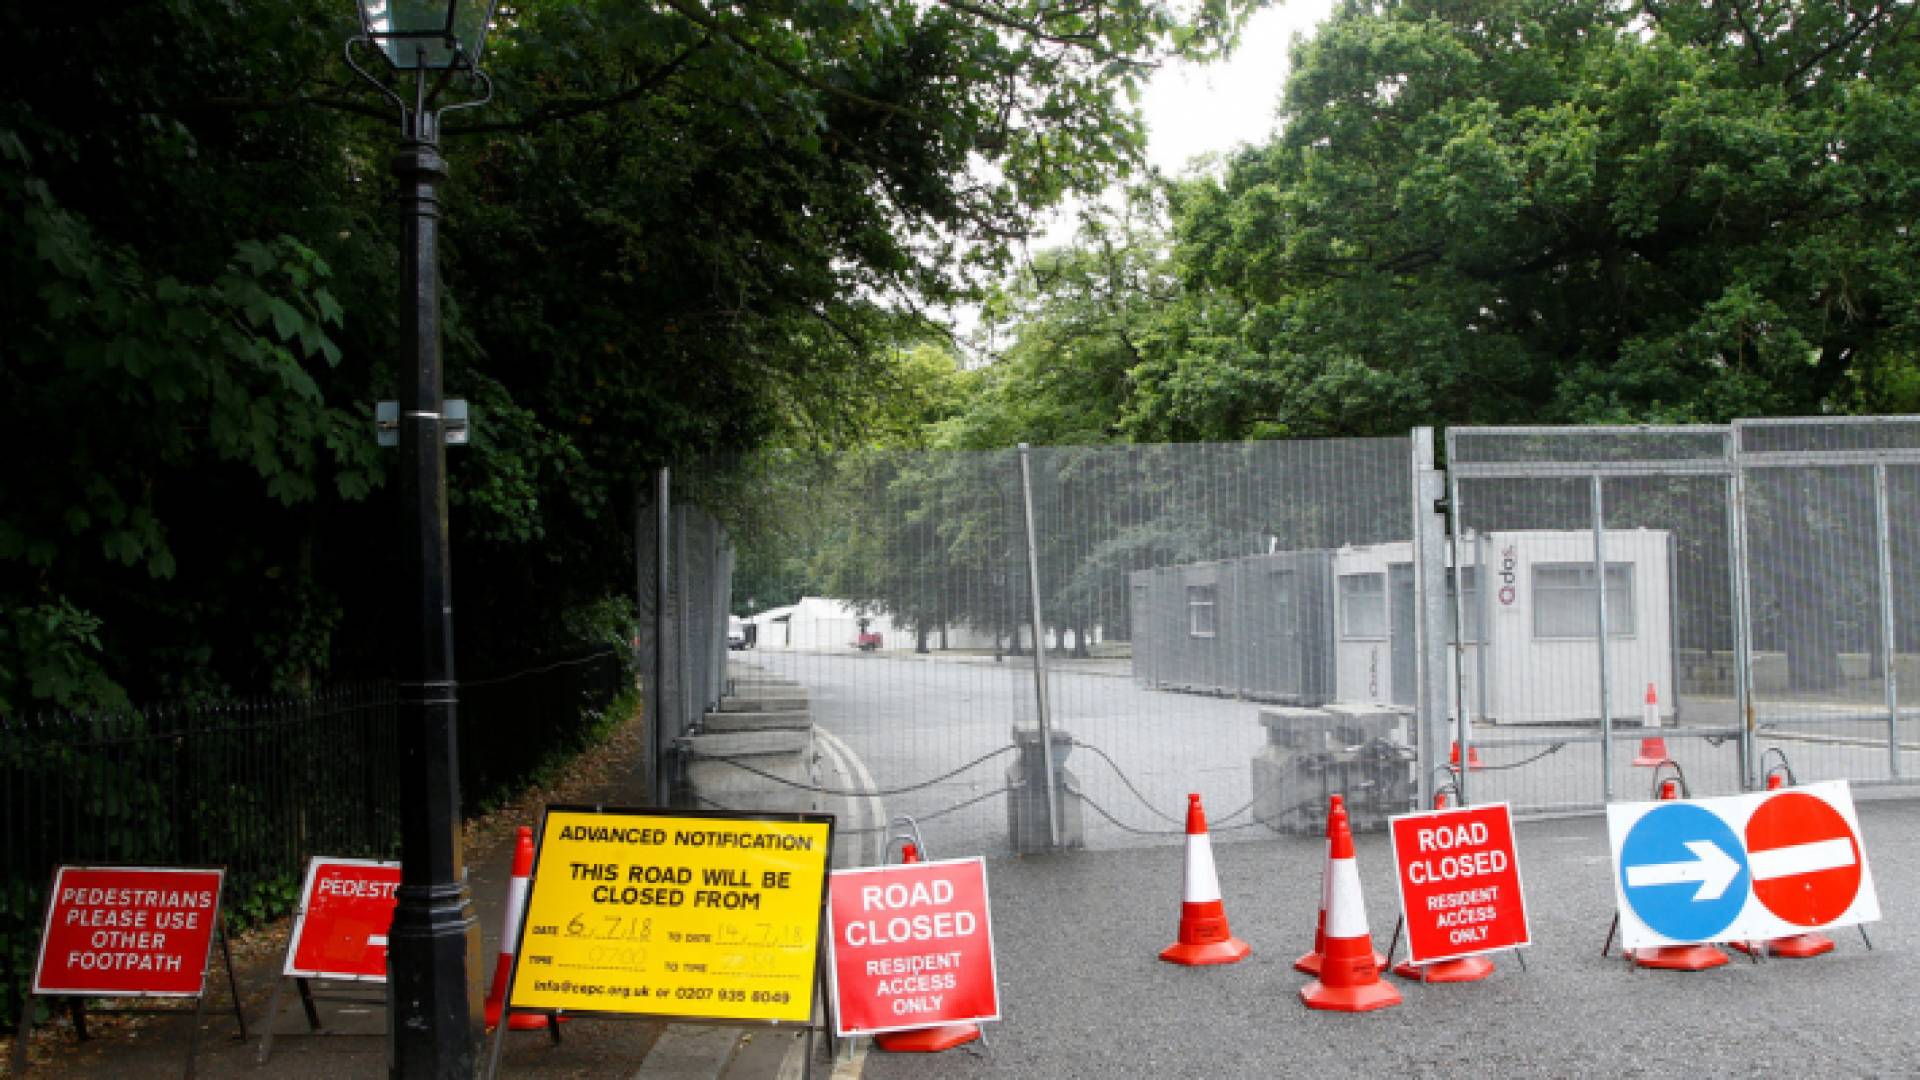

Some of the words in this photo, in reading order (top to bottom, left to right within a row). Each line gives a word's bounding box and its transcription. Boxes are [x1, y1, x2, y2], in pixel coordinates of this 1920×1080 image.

[559, 826, 667, 846] ADVANCED
[674, 831, 813, 851] NOTIFICATION
[1418, 821, 1489, 852] ROAD
[570, 863, 618, 881] THIS
[628, 866, 692, 885] ROAD
[702, 869, 751, 887] WILL
[762, 872, 792, 889] BE
[1409, 850, 1507, 884] CLOSED
[62, 888, 212, 908] PEDESTRIANS
[592, 886, 684, 906] CLOSED
[694, 891, 761, 910] FROM
[862, 879, 954, 911] ROAD
[1426, 886, 1499, 911] RESIDENT
[66, 909, 149, 927] PLEASE
[156, 912, 198, 929] USE
[1436, 906, 1497, 928] ACCESS
[532, 926, 559, 935] DATE
[685, 933, 711, 943] DATE
[844, 911, 976, 946] CLOSED
[1449, 925, 1489, 945] ONLY
[91, 931, 167, 949] OTHER
[67, 952, 182, 973] FOOTPATH
[529, 955, 552, 965] TIME
[683, 963, 707, 973] TIME
[865, 952, 962, 976] RESIDENT
[656, 987, 670, 997] or
[675, 987, 713, 1000] 0207
[877, 973, 957, 997] ACCESS
[892, 995, 943, 1016] ONLY
